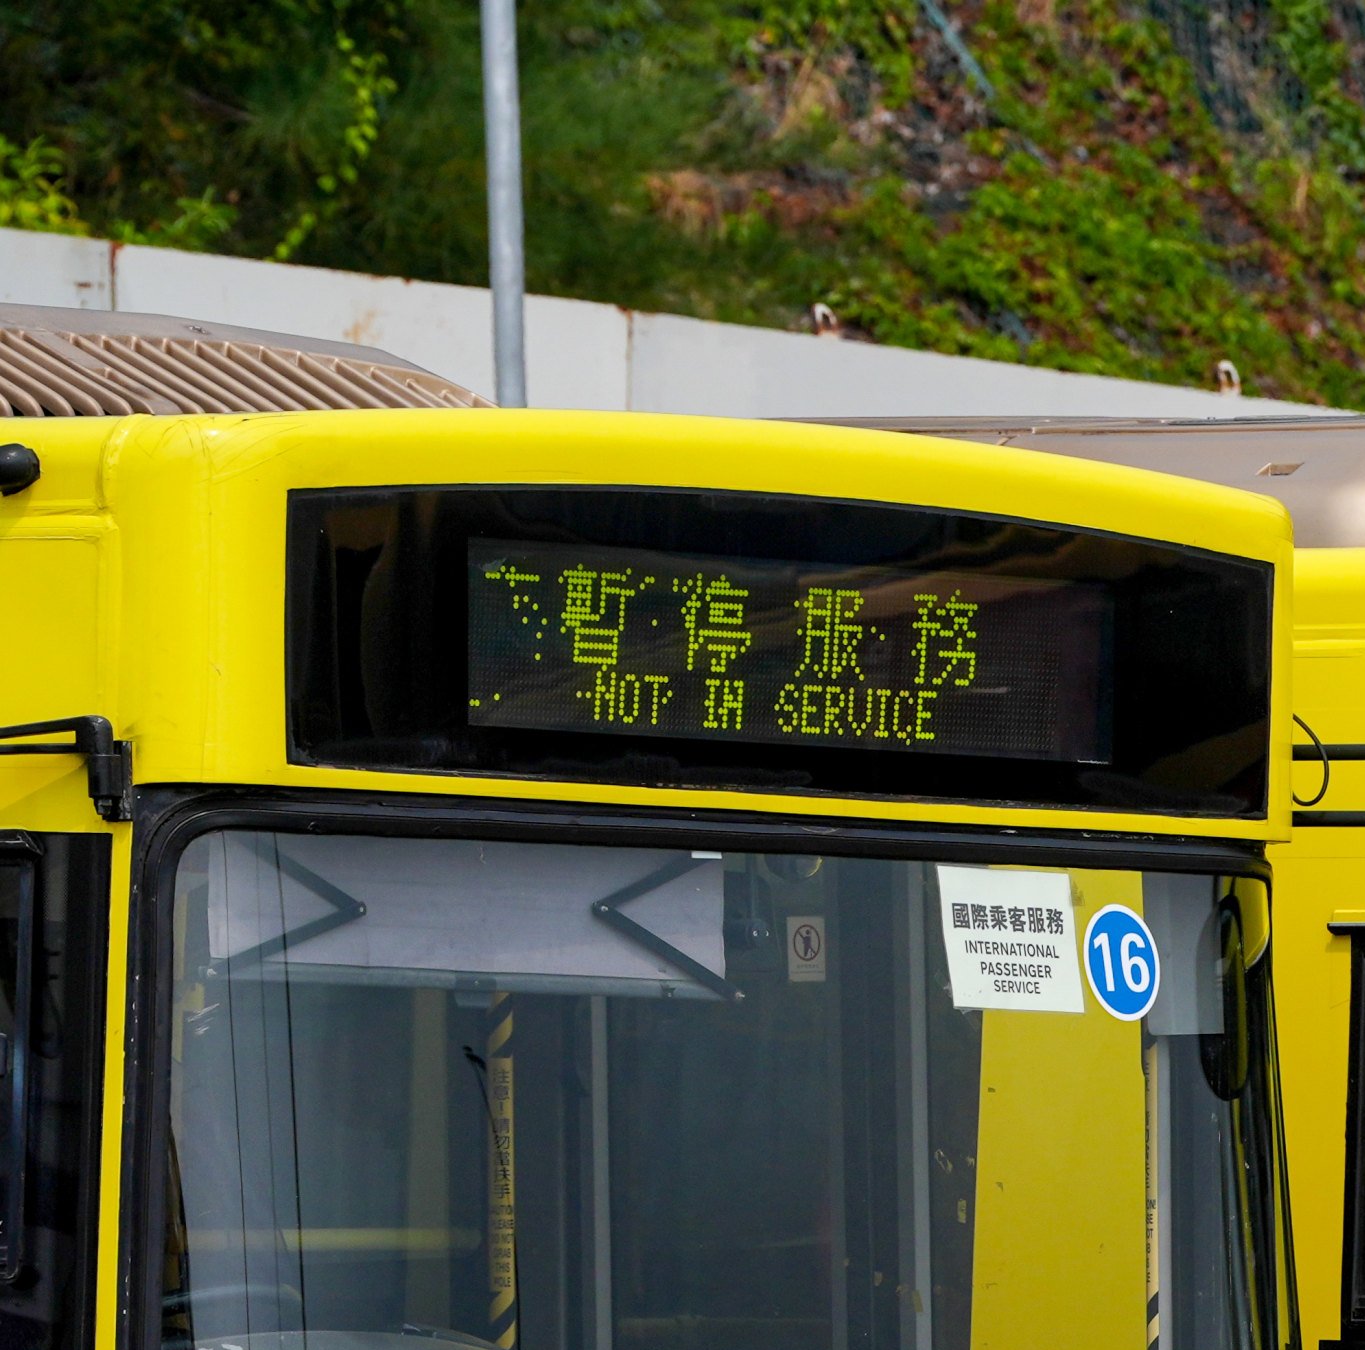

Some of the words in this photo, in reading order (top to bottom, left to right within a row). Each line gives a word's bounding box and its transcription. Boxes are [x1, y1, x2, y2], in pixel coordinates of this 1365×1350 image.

[593, 670, 669, 726] NOT
[773, 682, 937, 746] SERVICE
[951, 902, 1065, 936] 國際乘客服務
[964, 939, 1060, 959] INTERNATIONAL
[1093, 931, 1151, 994] 16
[980, 961, 1053, 979] PASSENGER
[993, 979, 1042, 995] SERVICE
